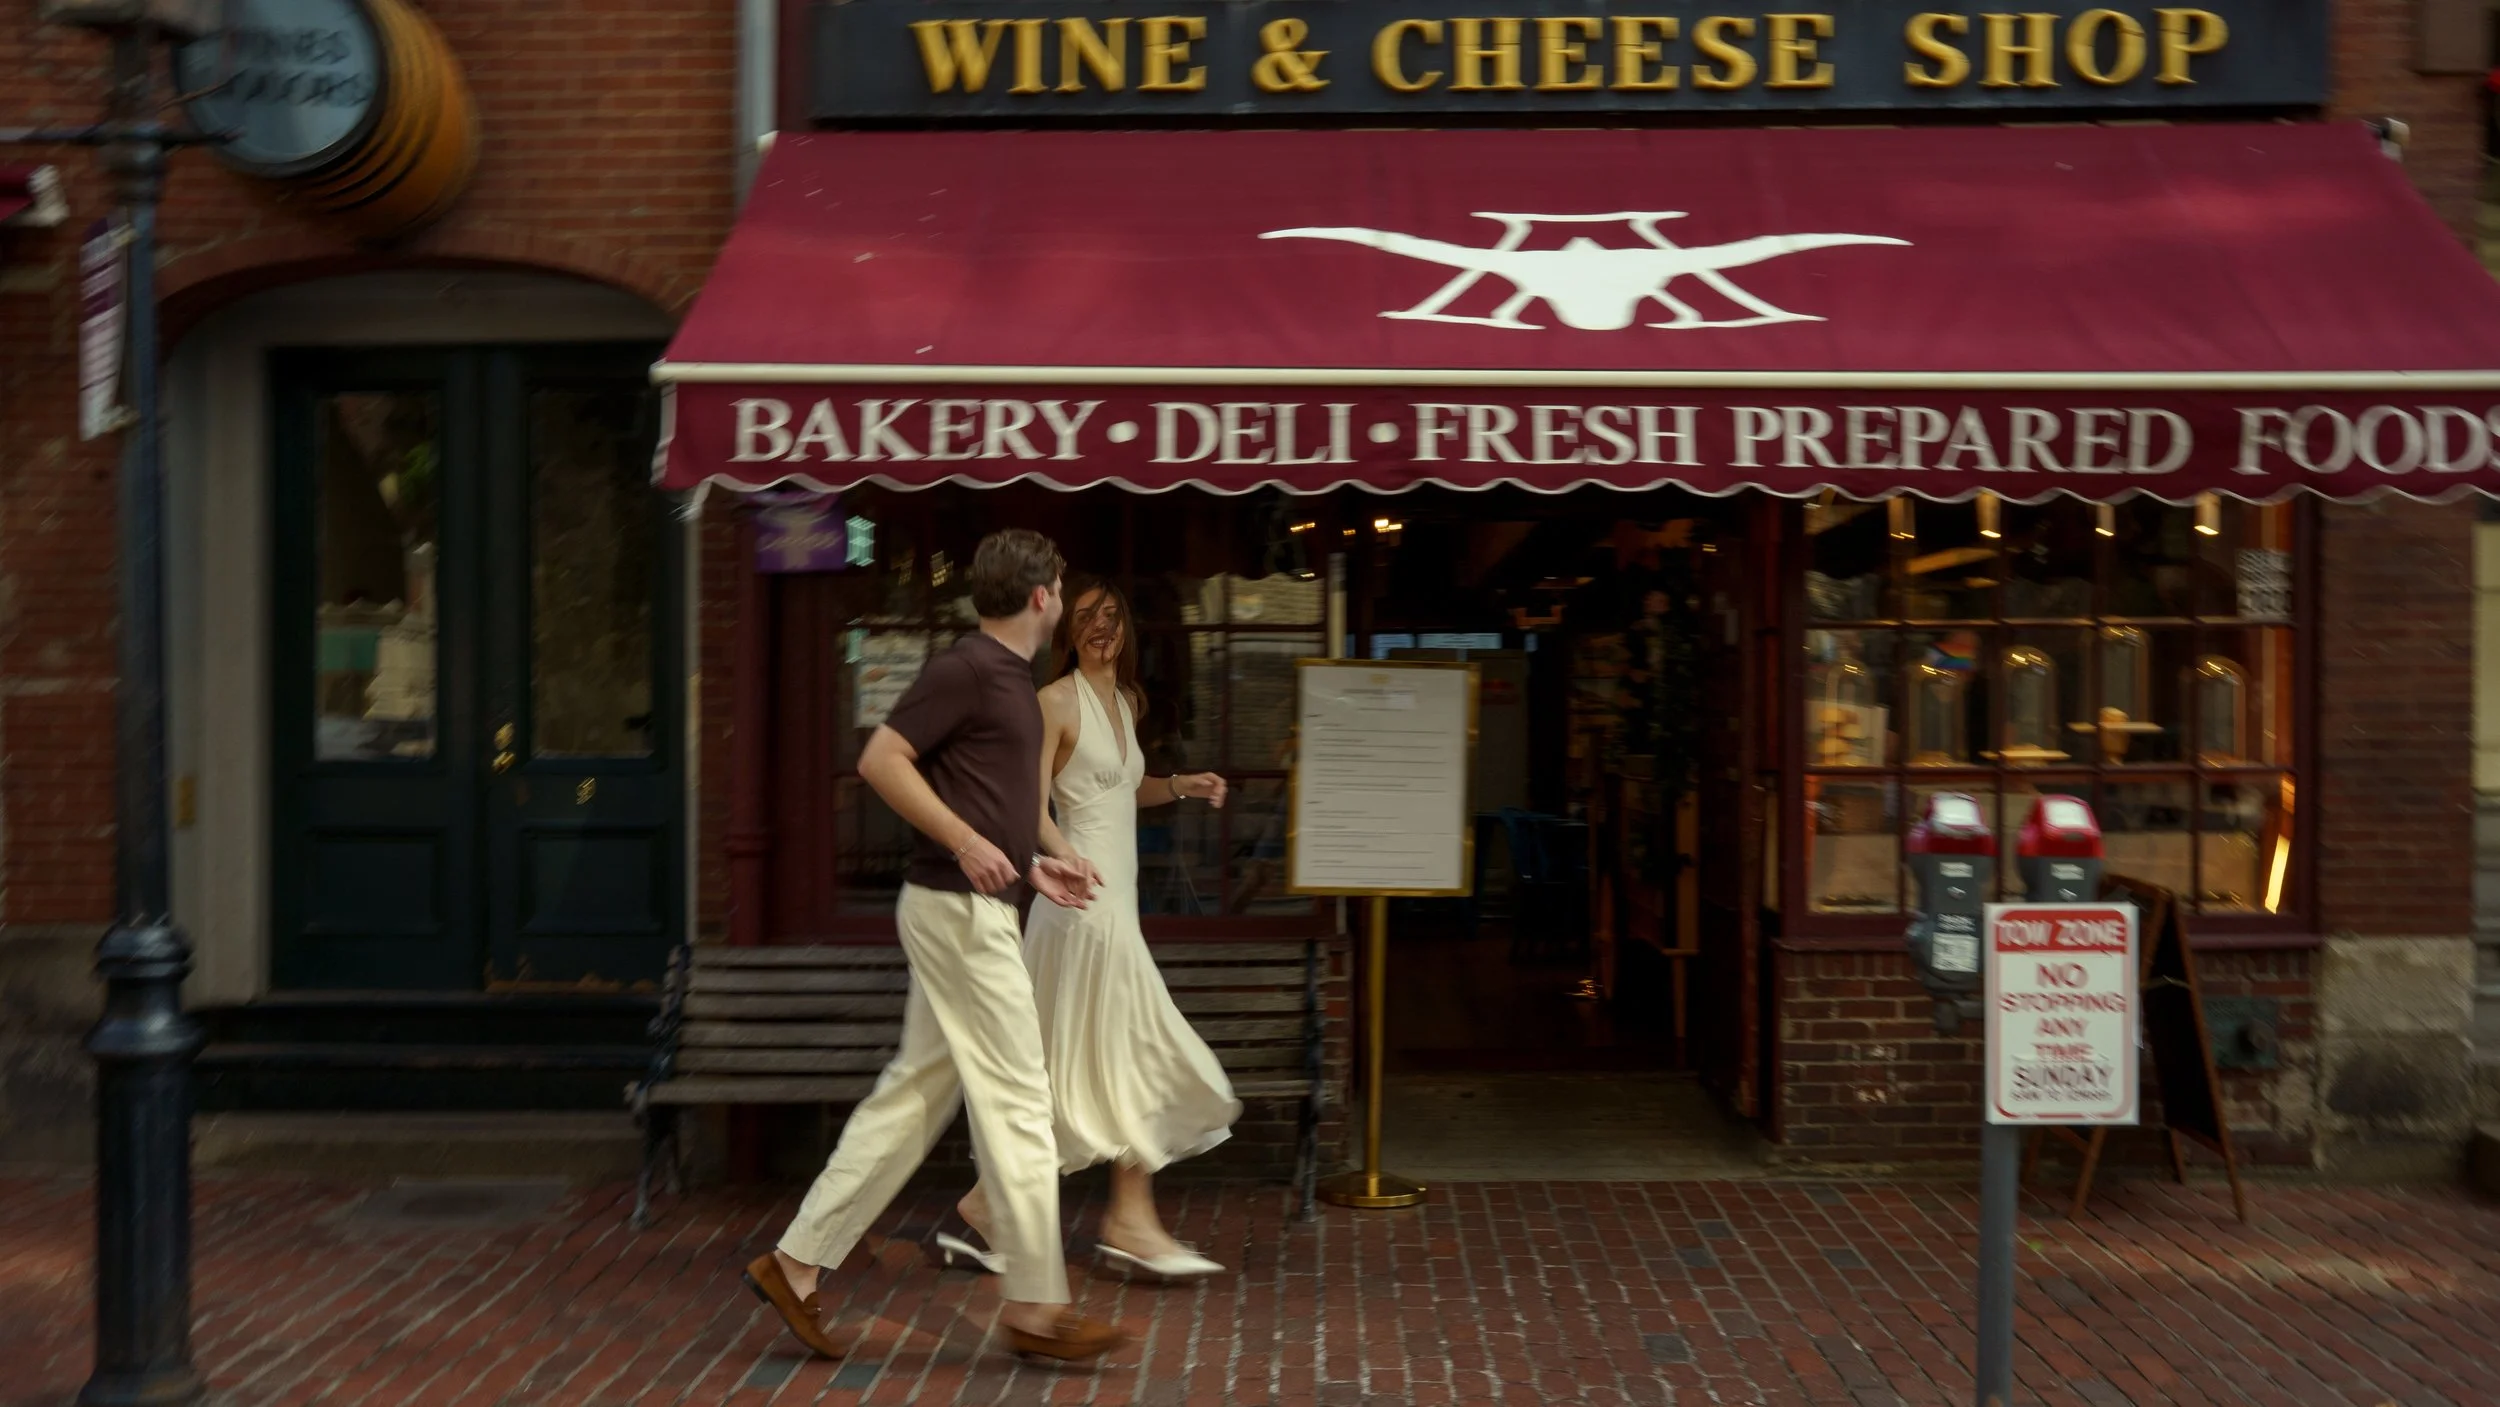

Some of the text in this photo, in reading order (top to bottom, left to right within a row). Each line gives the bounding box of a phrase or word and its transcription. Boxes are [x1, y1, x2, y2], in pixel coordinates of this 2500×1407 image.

[908, 8, 2230, 95] WINE & CHEESE SHOP
[726, 398, 1106, 464] BAKERY
[1147, 401, 1359, 465] DELI
[1407, 402, 1705, 467] FRESH
[1725, 405, 2194, 475] PREPARED
[1995, 919, 2053, 947] TOW
[2055, 918, 2127, 948] ZONE
[2035, 962, 2089, 988] NO
[1999, 992, 2127, 1013] STOPPING
[2035, 1017, 2090, 1037] ANY
[2031, 1043, 2094, 1060] TIME
[2010, 1063, 2116, 1088] SUNDAY
